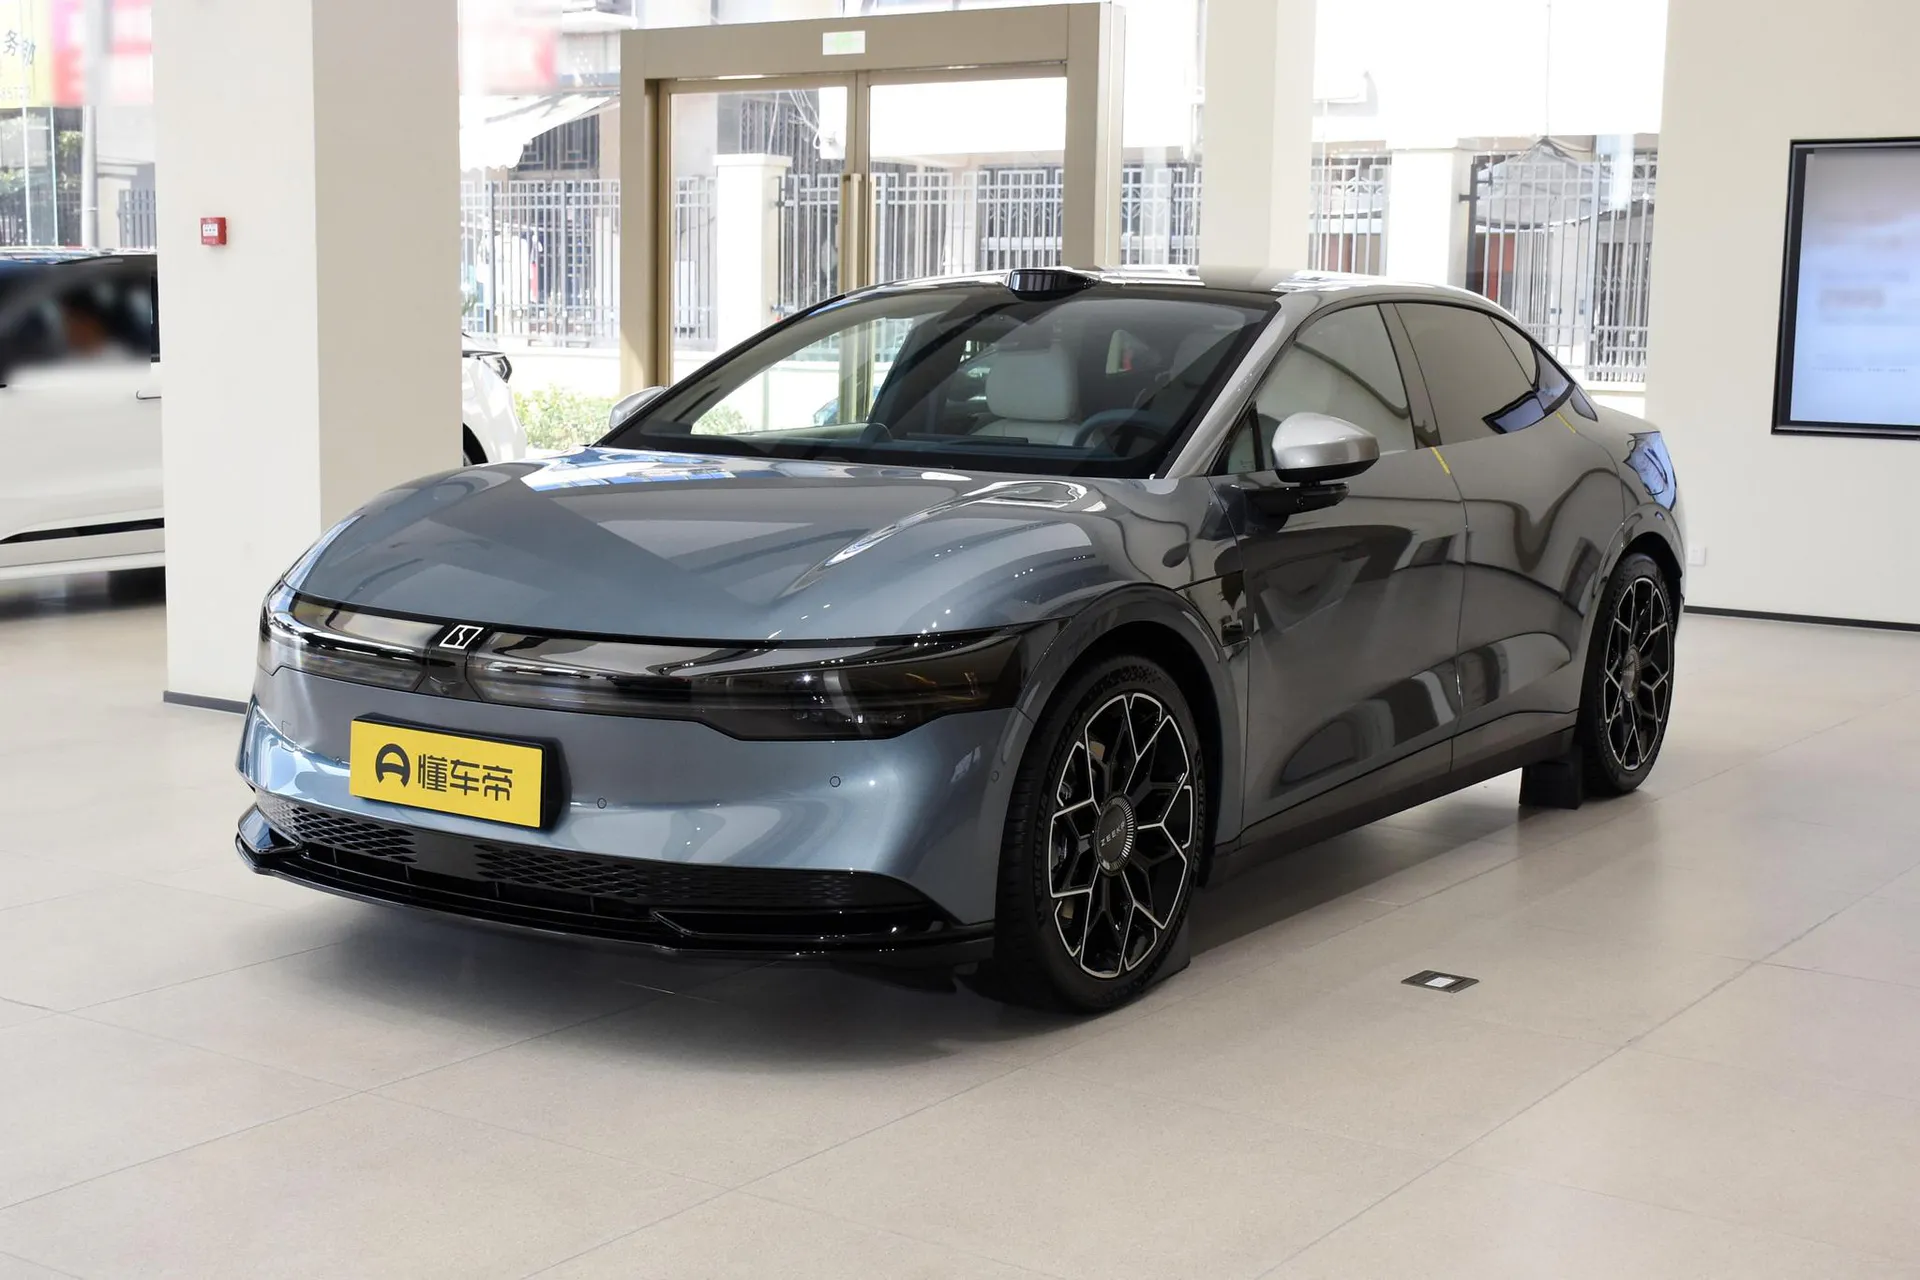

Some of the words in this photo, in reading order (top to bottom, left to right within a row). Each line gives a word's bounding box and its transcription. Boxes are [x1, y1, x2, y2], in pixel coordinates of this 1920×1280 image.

[418, 754, 513, 801] 懂车帝
[1099, 820, 1126, 848] ZEEKR
